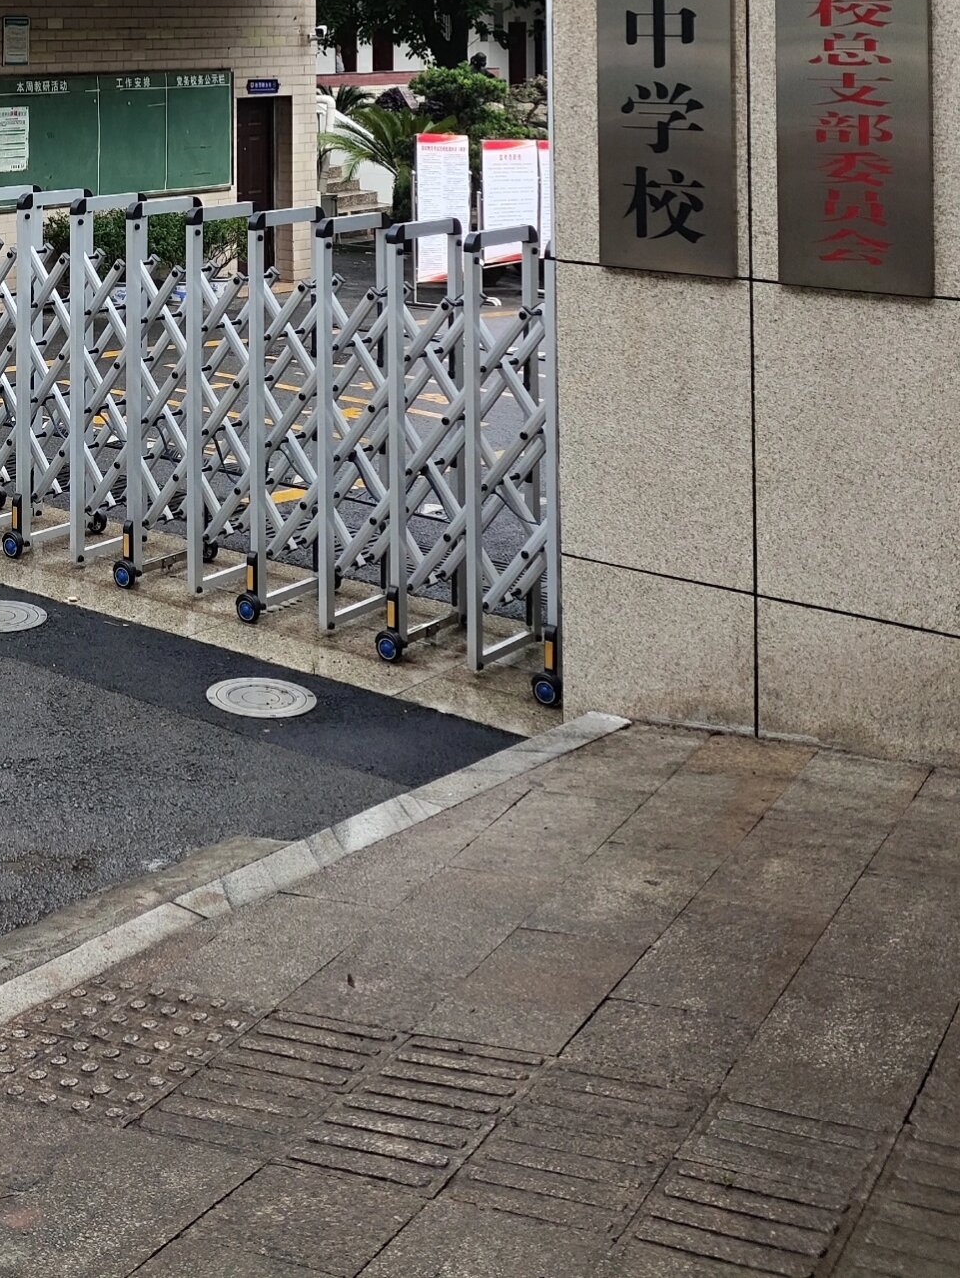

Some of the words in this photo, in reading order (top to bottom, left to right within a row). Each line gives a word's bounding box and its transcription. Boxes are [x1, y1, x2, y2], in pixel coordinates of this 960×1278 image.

[16, 80, 69, 92] 本周教研活动
[116, 77, 151, 88] 工作安排
